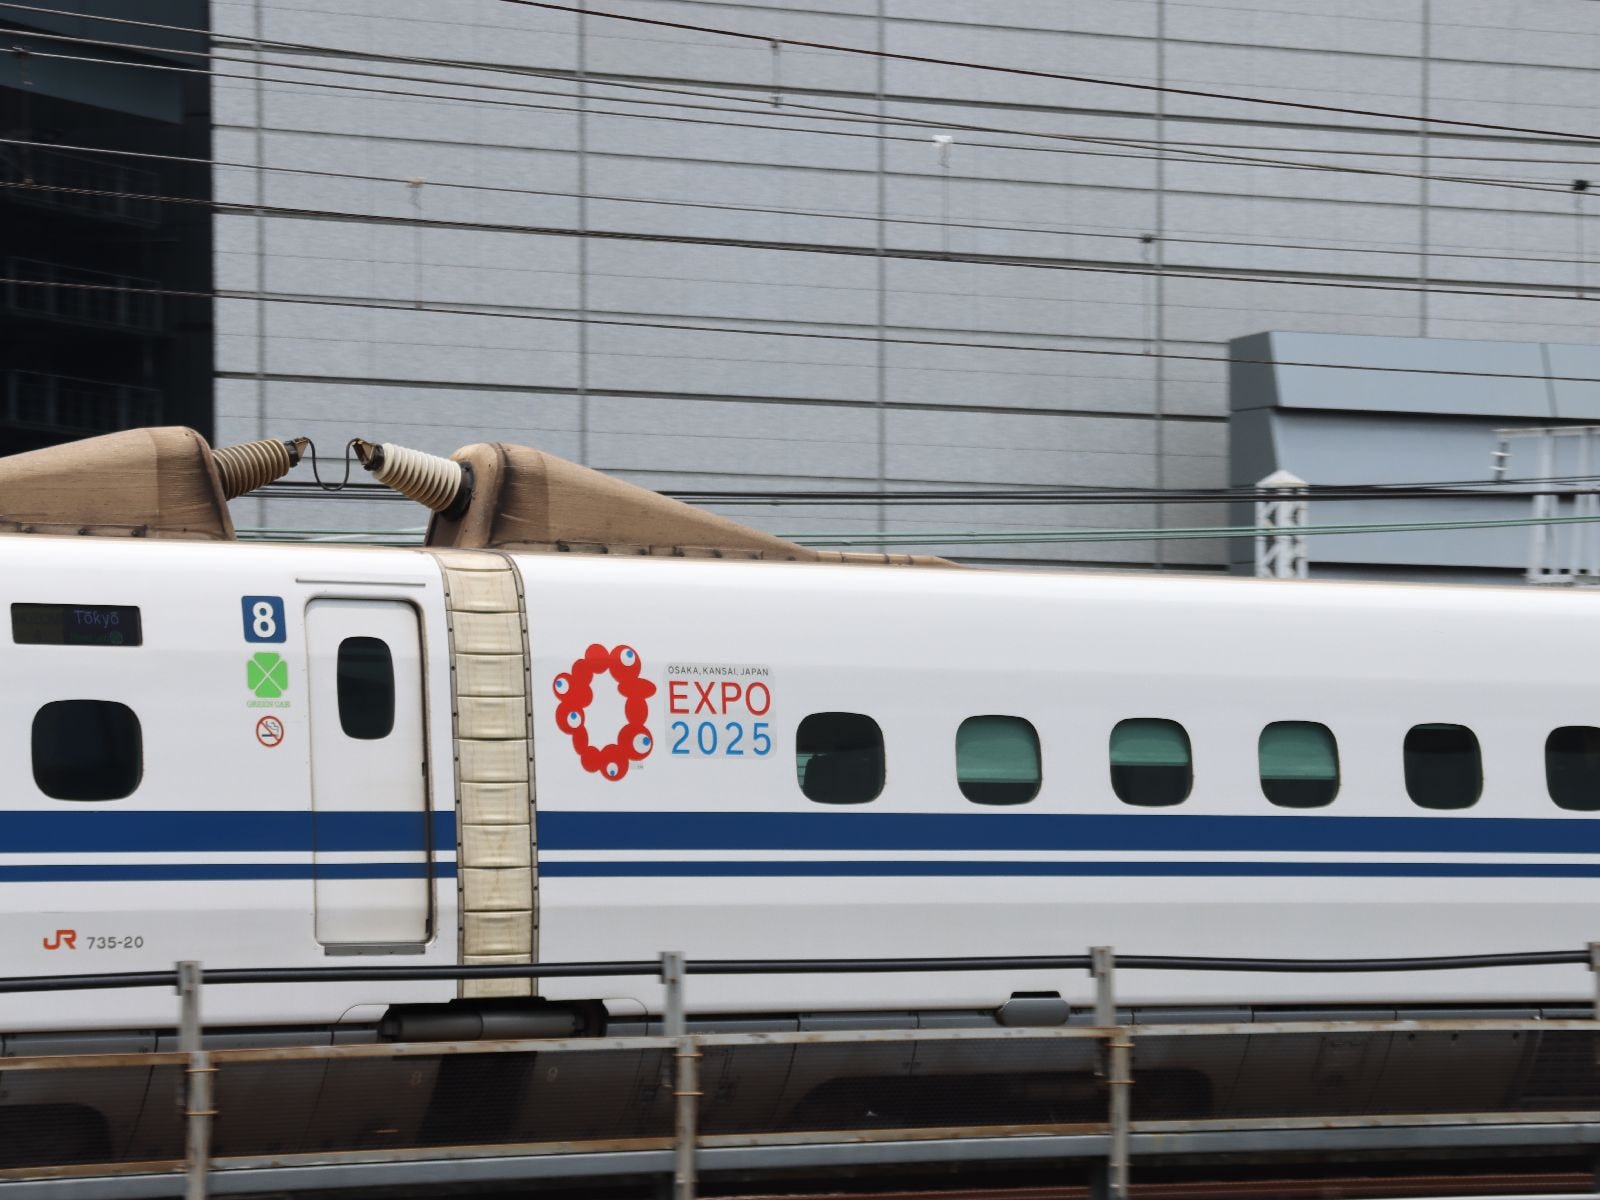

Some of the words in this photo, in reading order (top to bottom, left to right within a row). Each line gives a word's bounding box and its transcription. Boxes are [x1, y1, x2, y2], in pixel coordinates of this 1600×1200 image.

[252, 601, 276, 638] 8
[668, 681, 771, 716] EXPO
[671, 721, 771, 756] 2025
[43, 929, 77, 950] JR
[86, 936, 144, 950] 735-20
